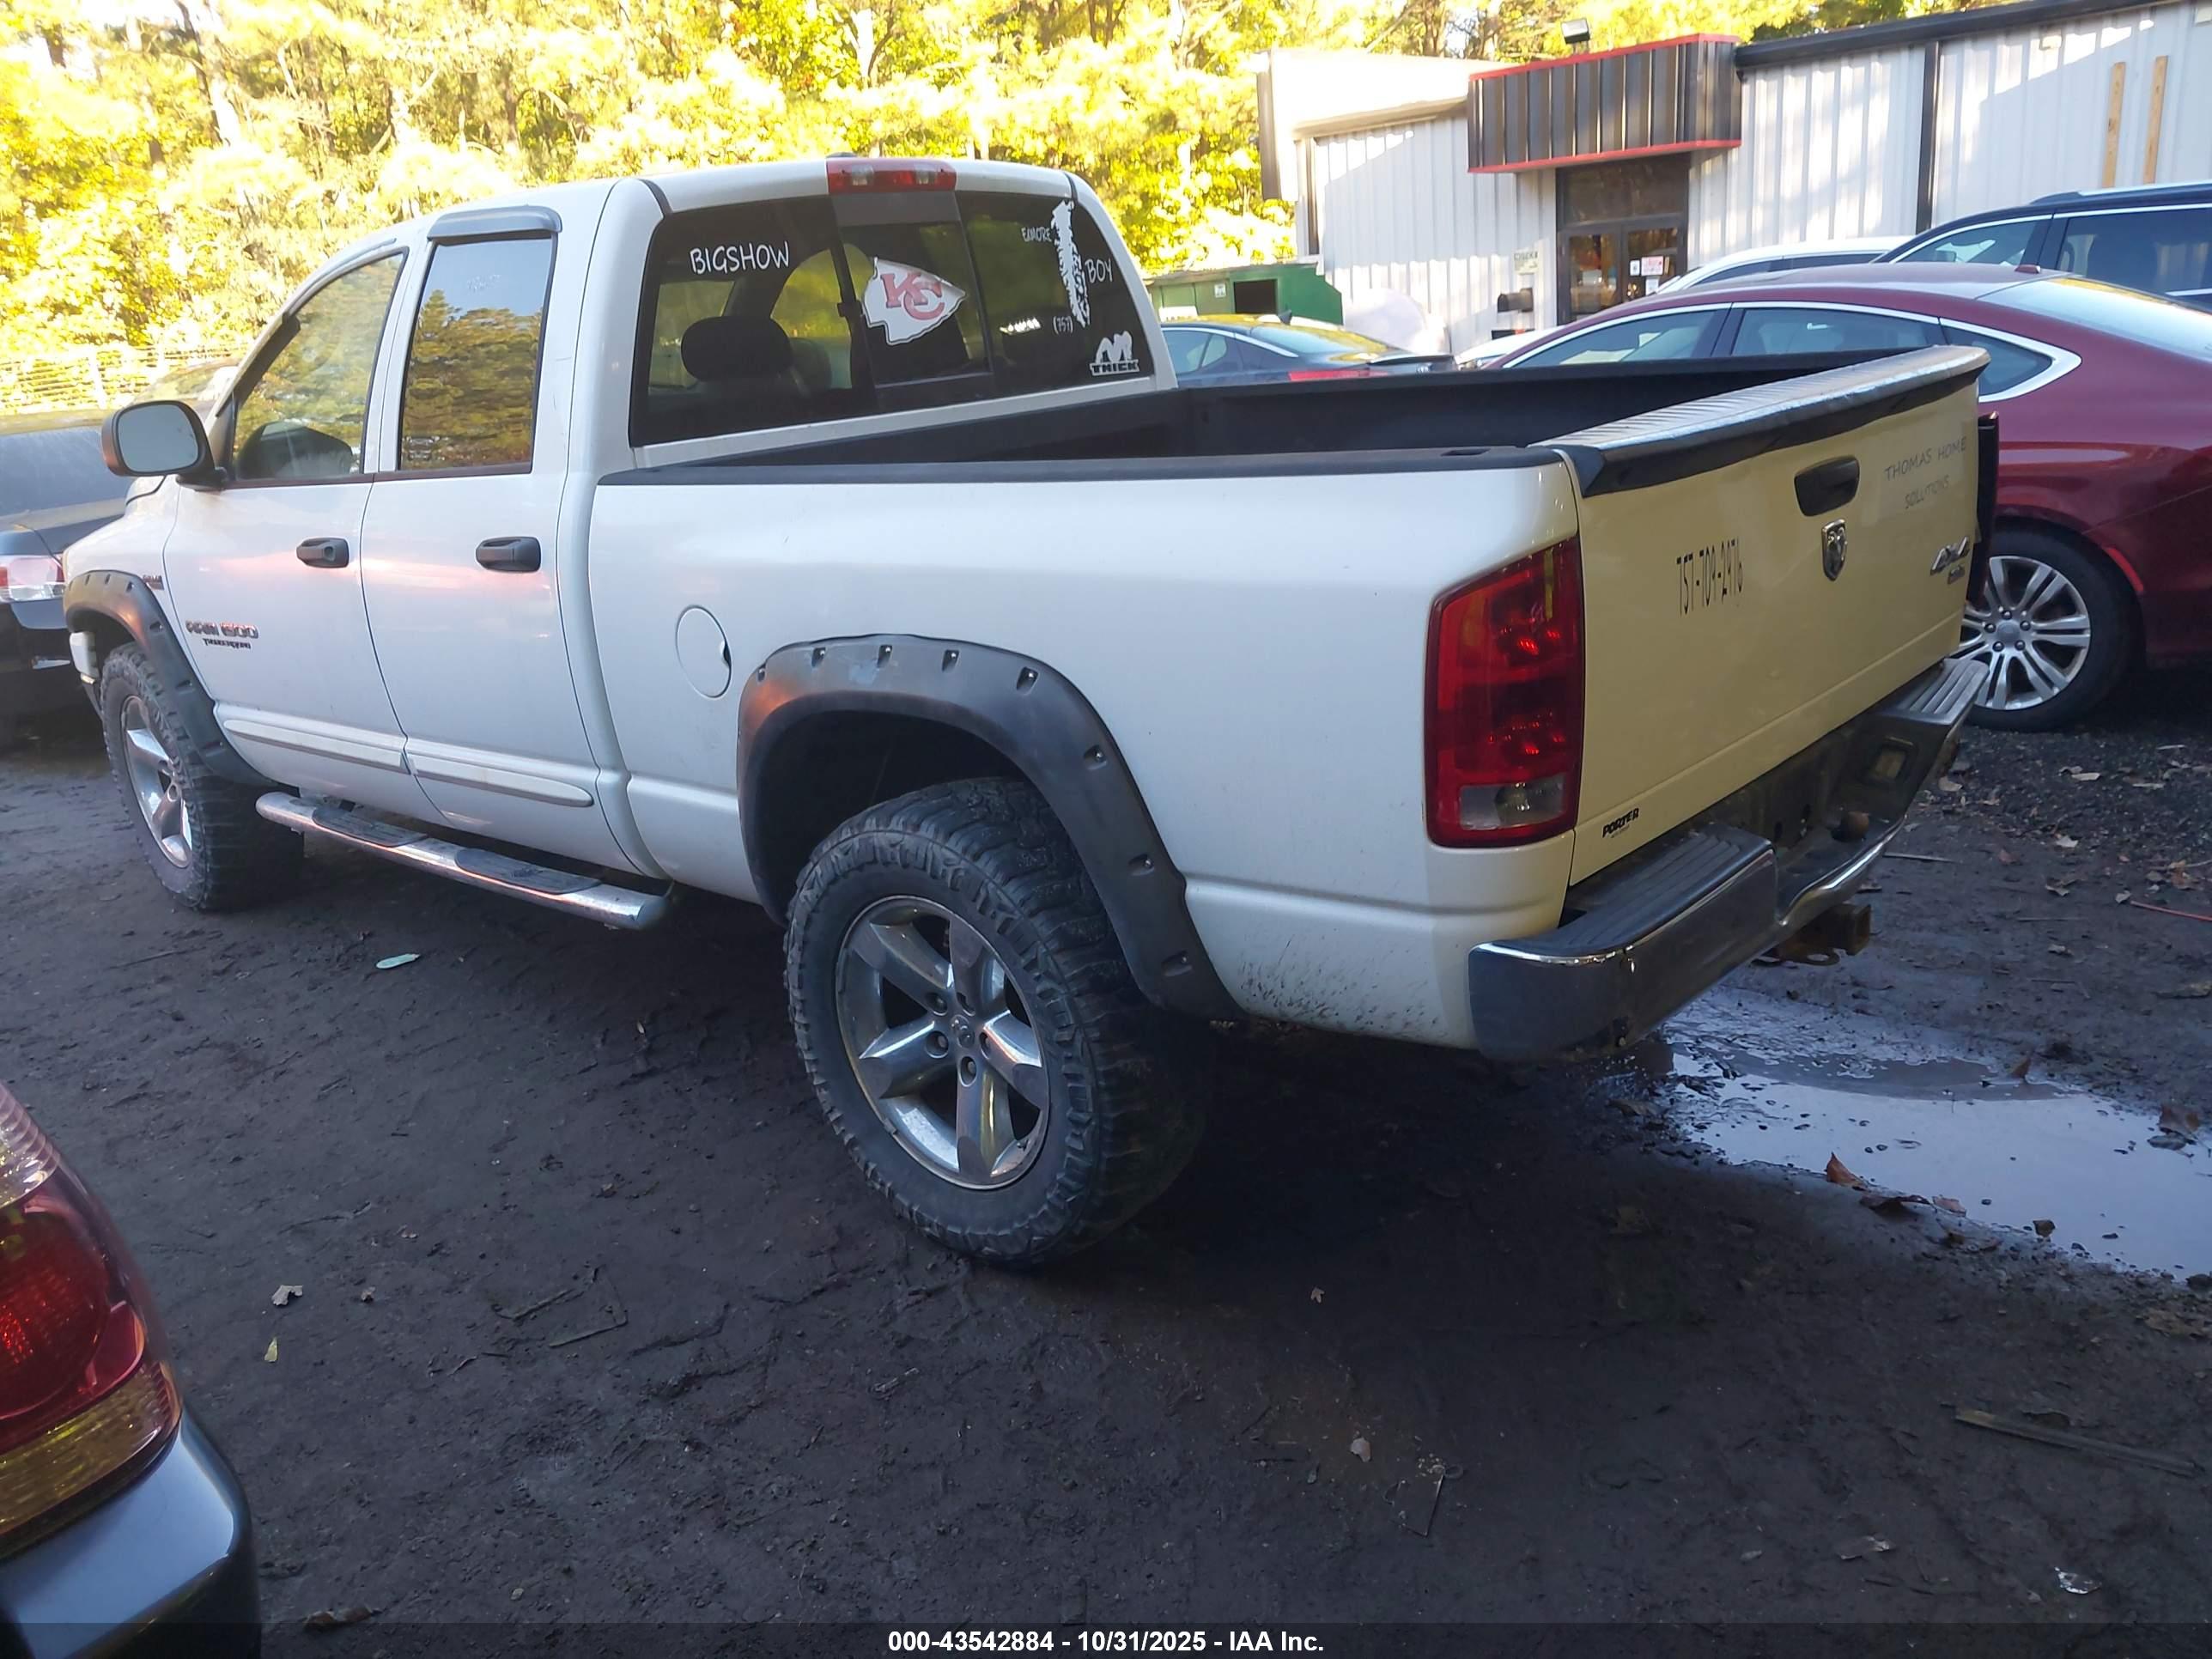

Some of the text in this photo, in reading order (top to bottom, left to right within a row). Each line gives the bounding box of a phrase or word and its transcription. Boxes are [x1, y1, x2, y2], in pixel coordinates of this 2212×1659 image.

[690, 240, 789, 274] BIGSHOW
[1085, 258, 1113, 283] BOY
[880, 272, 945, 320] KC
[1885, 436, 1966, 481] THOMAS HOME
[1602, 808, 1639, 838] PORTER
